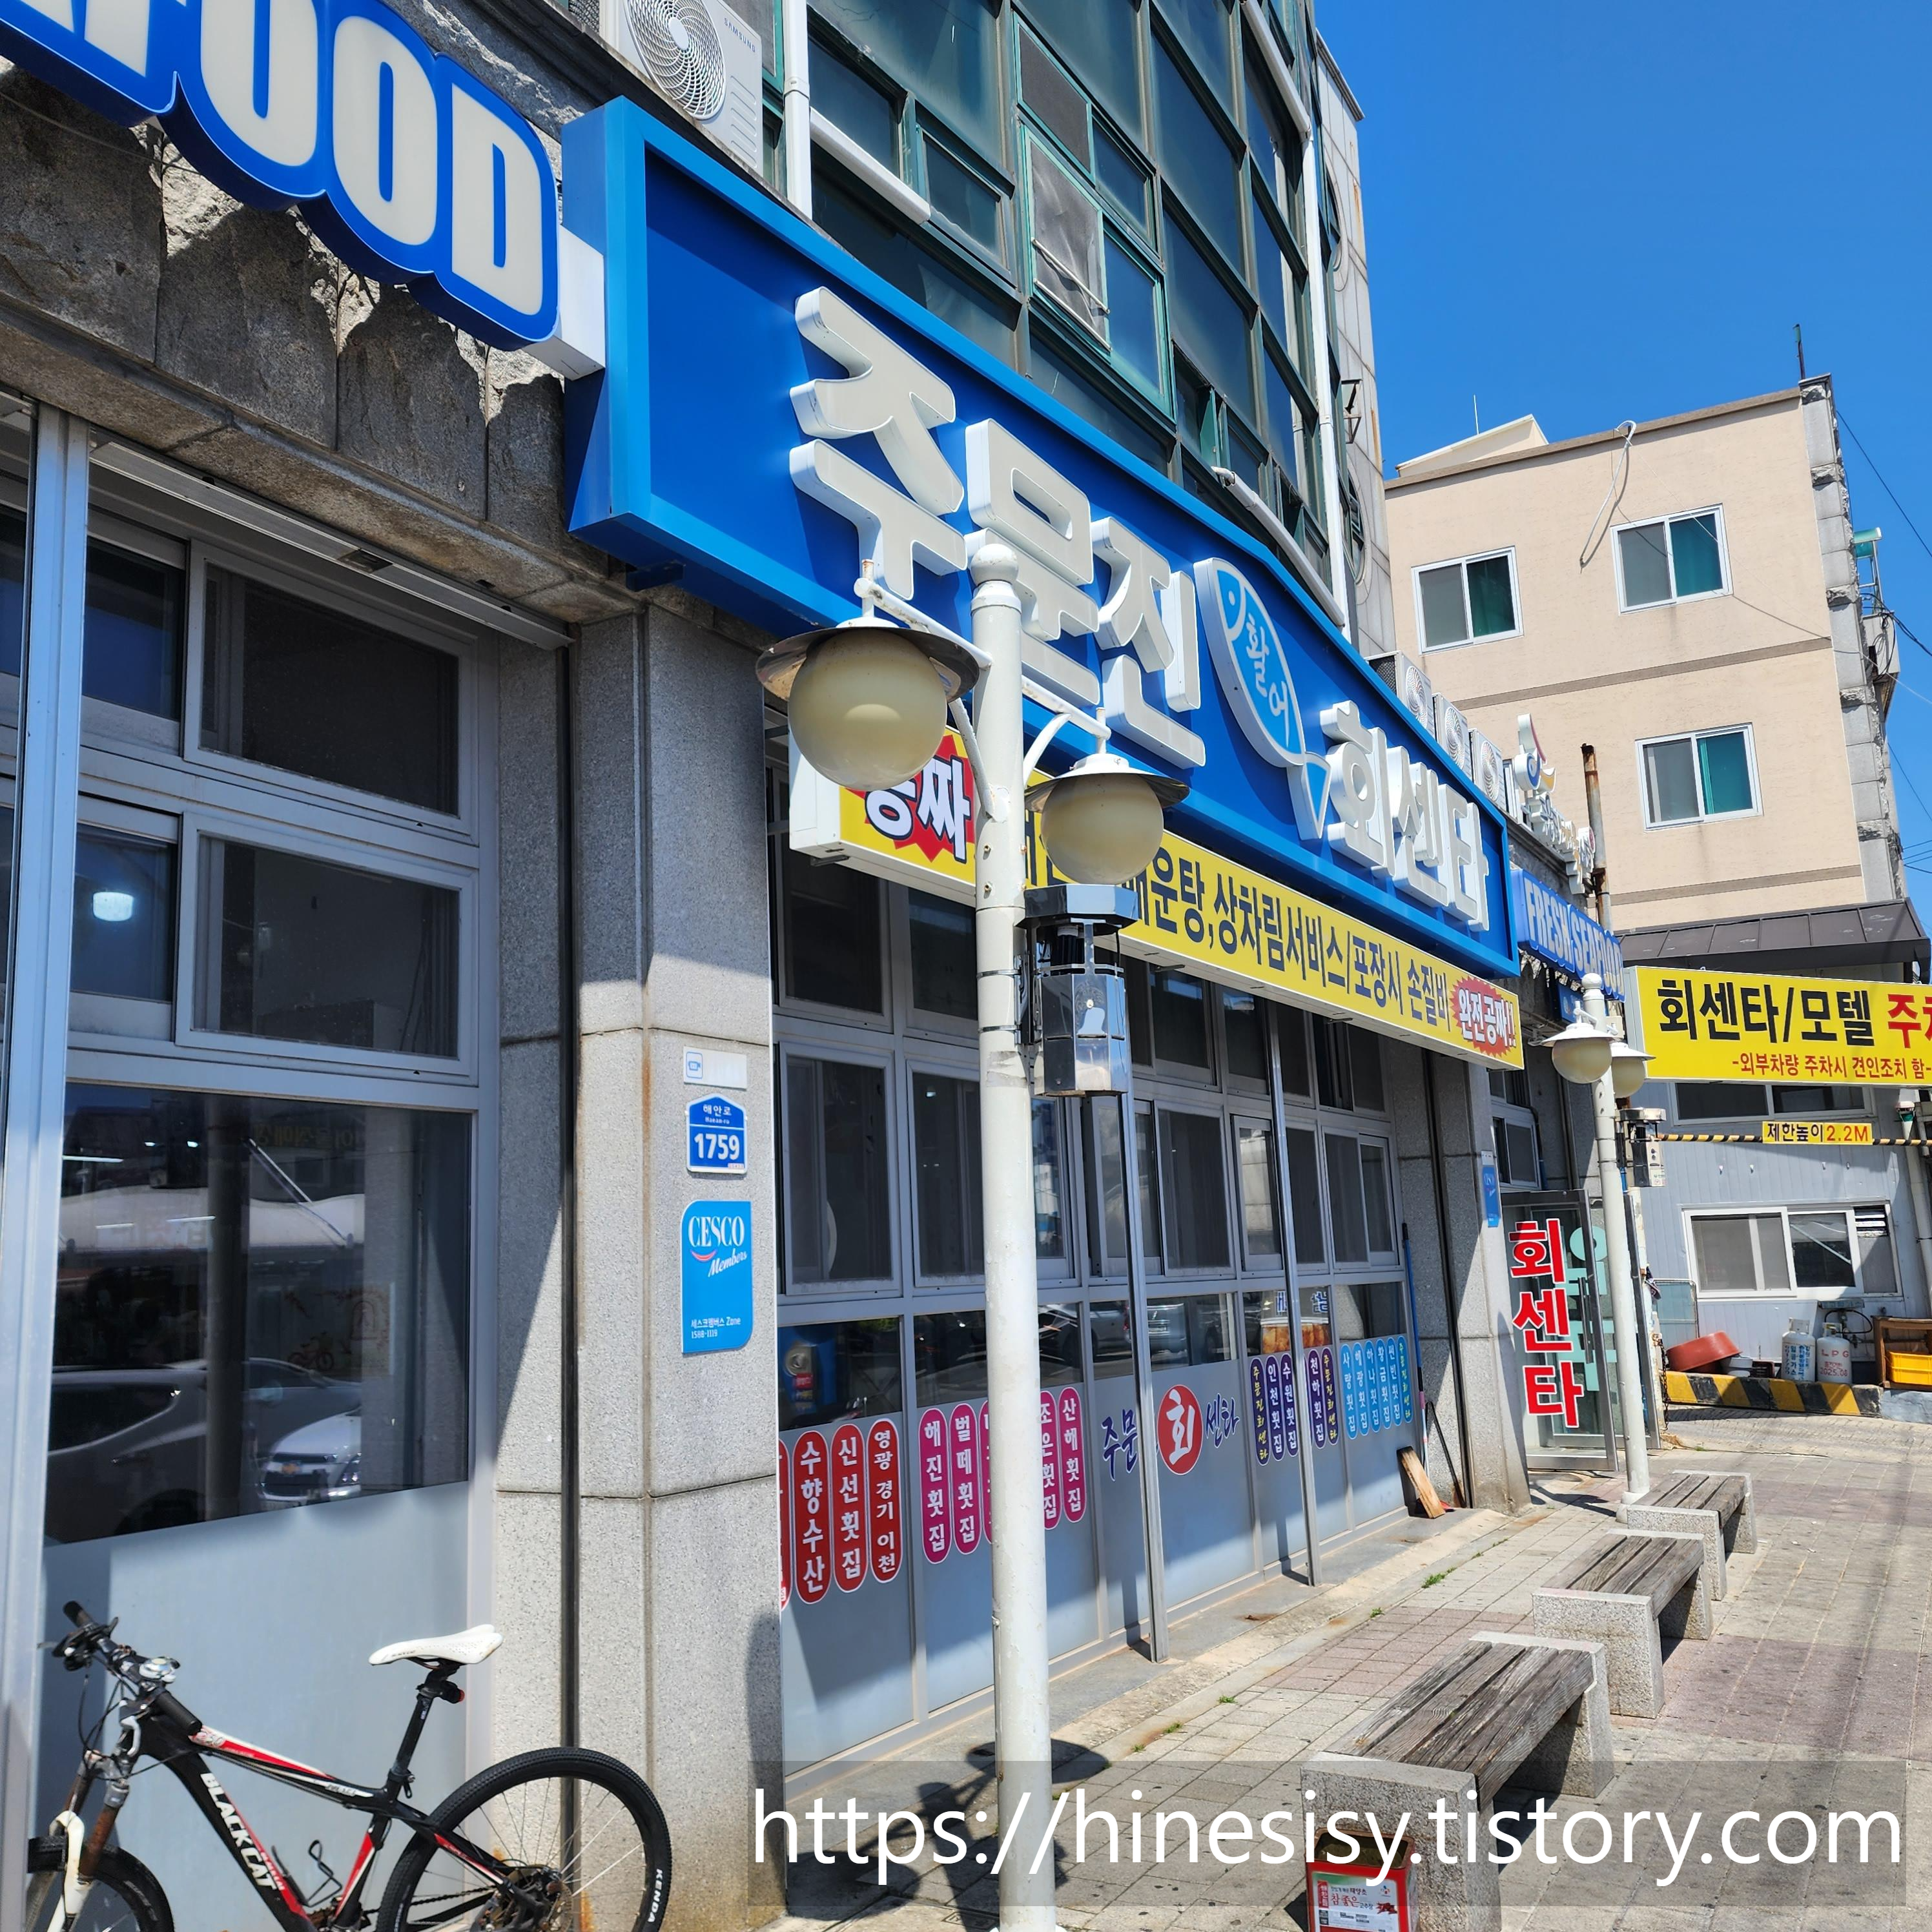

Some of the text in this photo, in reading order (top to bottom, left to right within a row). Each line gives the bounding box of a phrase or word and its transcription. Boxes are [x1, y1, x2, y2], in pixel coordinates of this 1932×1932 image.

[724, 17, 755, 53] SAMSUNG
[6, 0, 542, 315] OOD
[790, 286, 1489, 932] 주문진 회센타
[1246, 612, 1290, 748] 활어
[1524, 877, 1625, 998] FRESH SEAFOOD
[1408, 959, 1450, 1032] 손질비
[1657, 979, 1875, 1047] 회센타/모텔
[1804, 1054, 1847, 1078] 주차시
[1851, 1056, 1907, 1080] 견인조치
[694, 1133, 740, 1160] 1759
[703, 1104, 732, 1117] 해안로
[1767, 1123, 1869, 1142] 제한높이 2.2M
[688, 1216, 745, 1248] CESCO
[708, 1248, 748, 1278] Members
[726, 1316, 741, 1326] Zone
[1508, 1218, 1584, 1428] 회센타
[1822, 1348, 1849, 1358] LPG
[1268, 1364, 1282, 1454] 인천횟집
[1282, 1362, 1297, 1449] 수원횟집
[1310, 1357, 1324, 1441] 천하횟집
[1343, 1351, 1355, 1432] 사랑횟집
[1366, 1348, 1379, 1425] 하나횟집
[1377, 1346, 1390, 1422] 황금횟집
[1062, 1397, 1082, 1512] 산해횟집
[1101, 1408, 1138, 1481] 주문
[1166, 1388, 1195, 1465] 회
[800, 1441, 825, 1593] 수향수산
[838, 1436, 861, 1579] 신선횟집
[955, 1415, 975, 1543] 벌떼횟집
[200, 1773, 253, 1848] BLACK
[240, 1847, 277, 1891] CAT
[647, 1868, 663, 1923] KENDA
